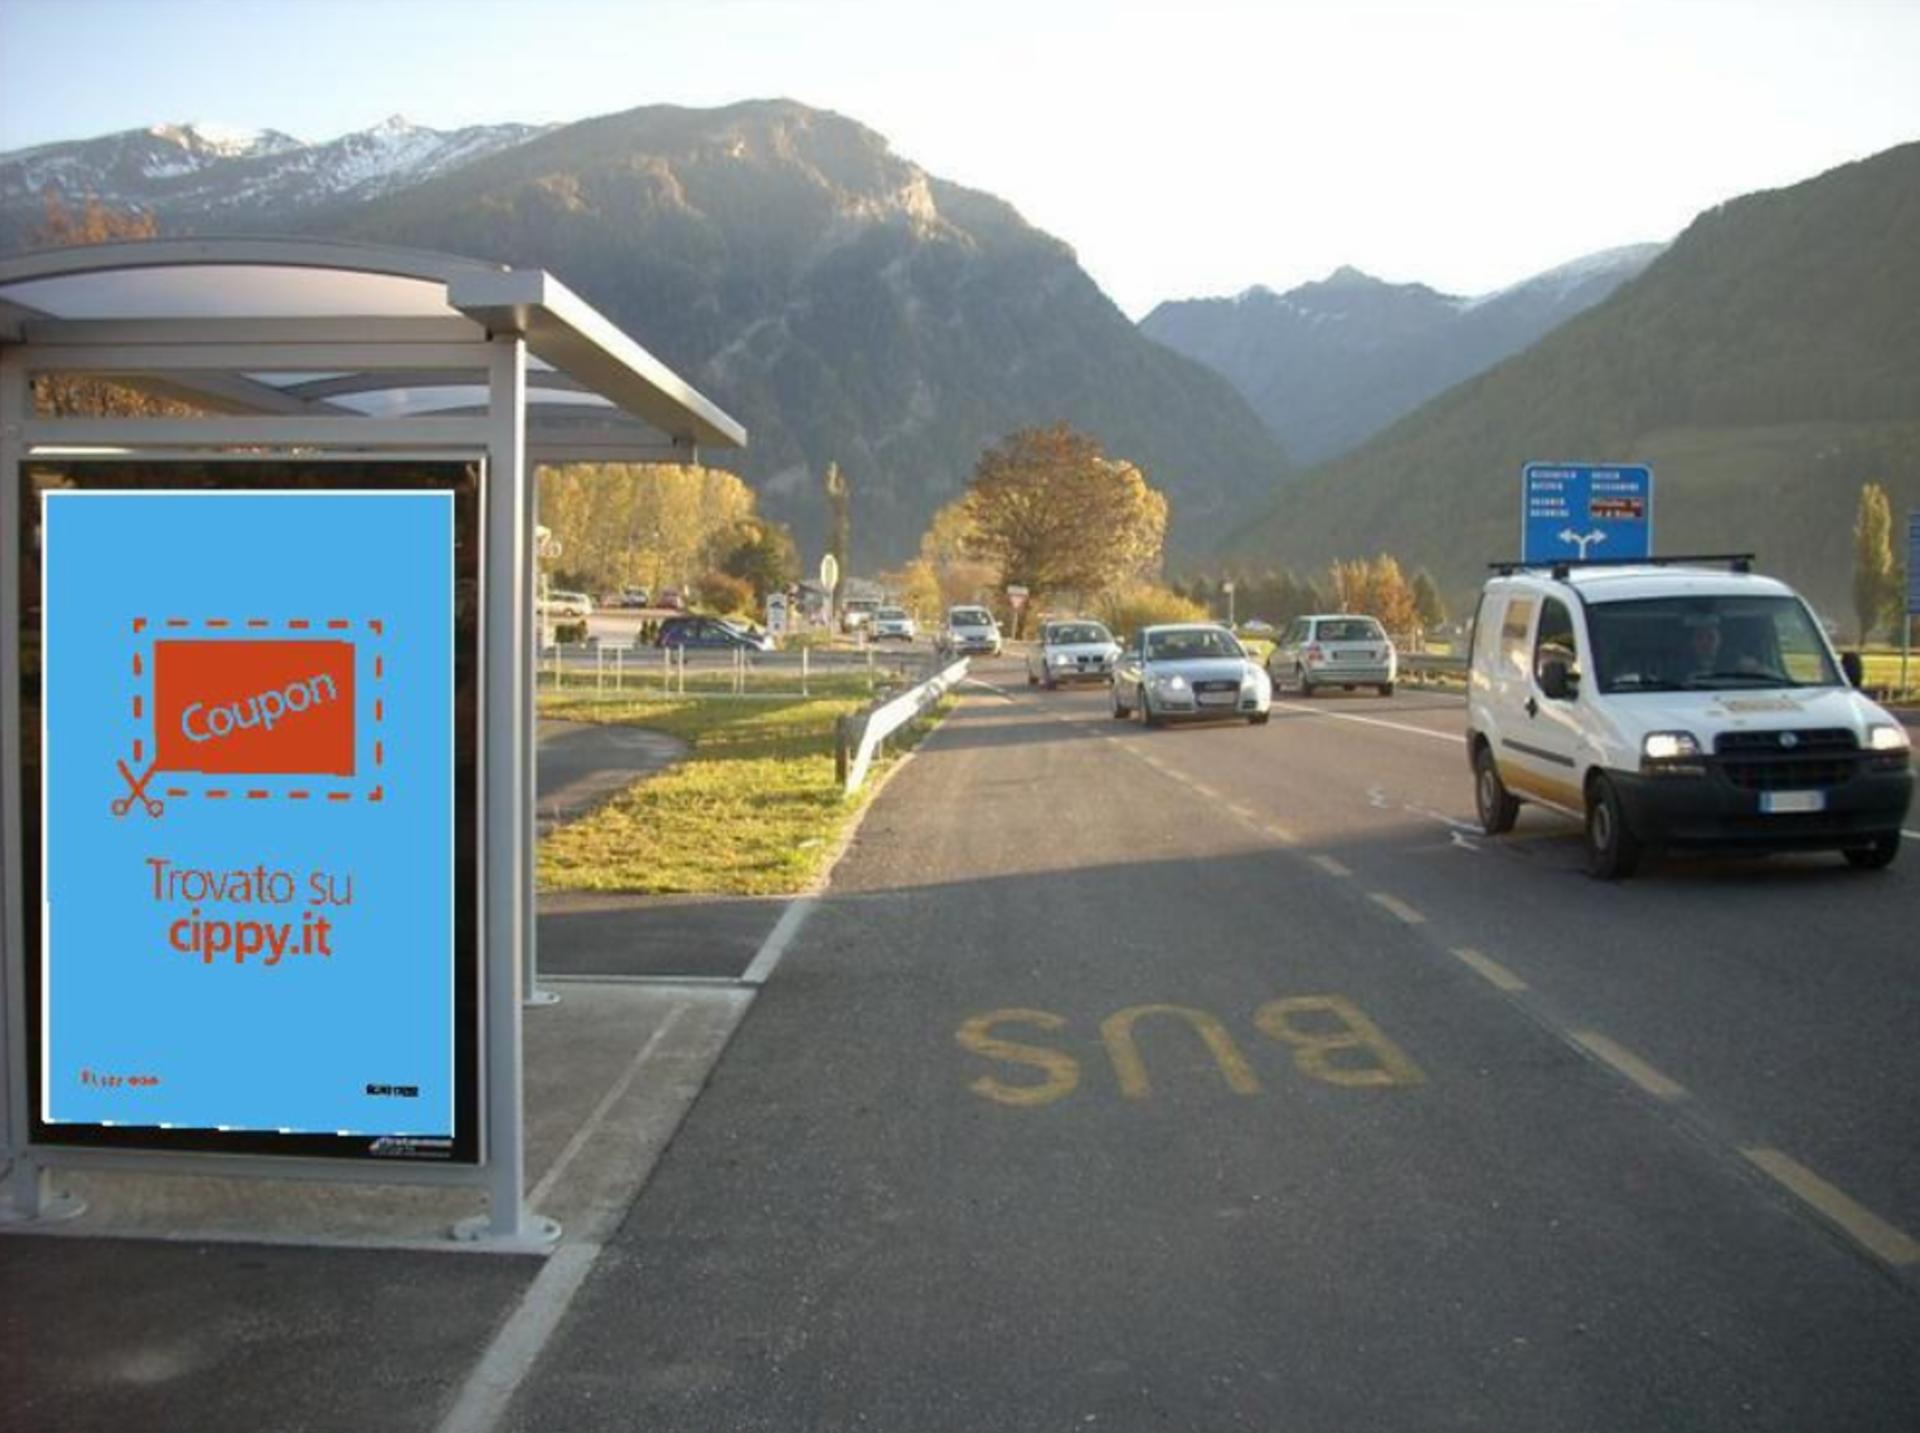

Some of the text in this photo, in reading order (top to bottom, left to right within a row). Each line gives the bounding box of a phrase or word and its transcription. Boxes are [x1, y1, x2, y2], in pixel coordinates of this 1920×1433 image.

[180, 673, 337, 742] Coupon
[145, 858, 352, 906] Trovato su
[168, 908, 332, 966] cippy.it
[955, 994, 1427, 1108] BUS
